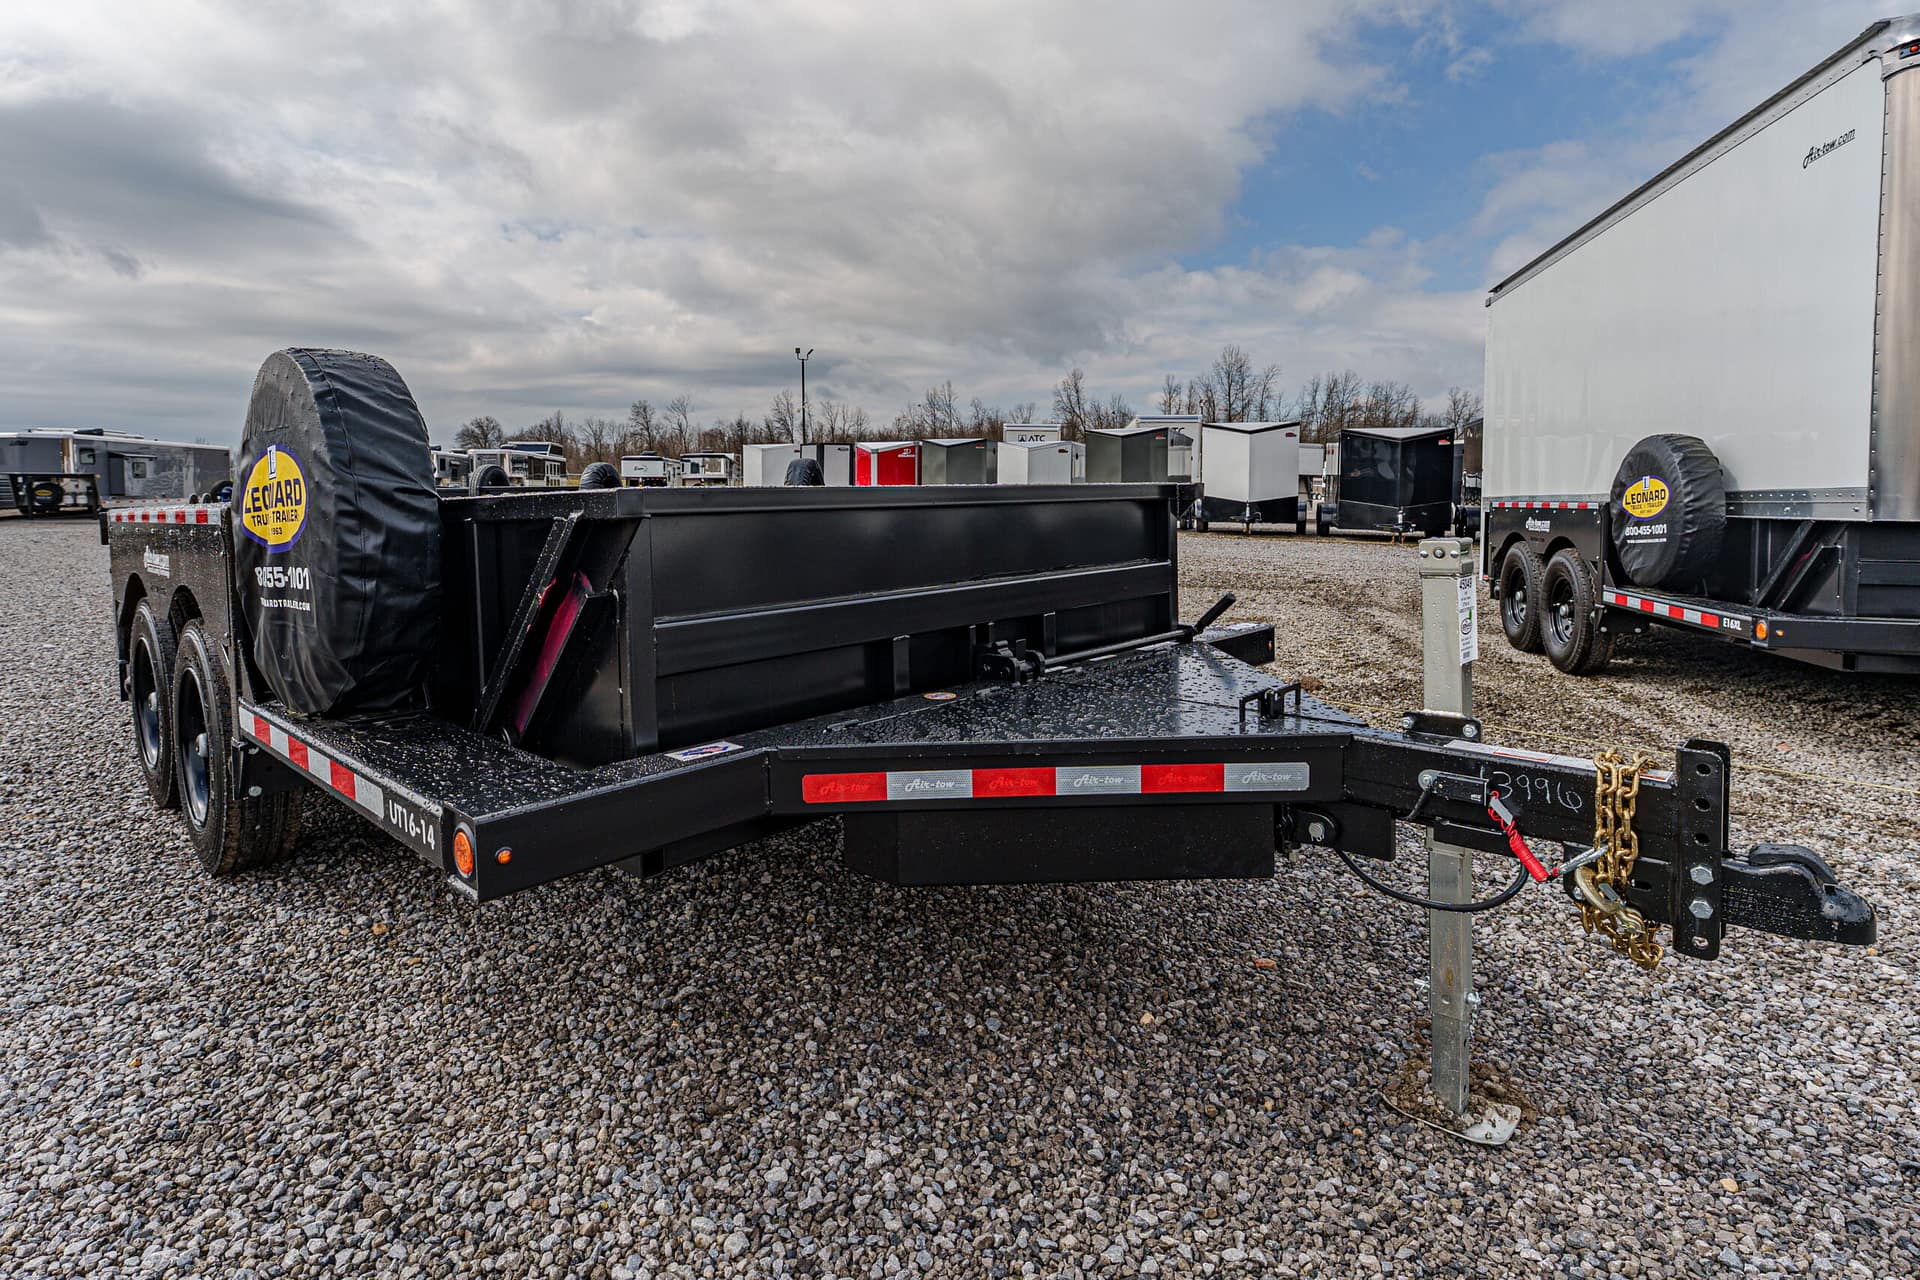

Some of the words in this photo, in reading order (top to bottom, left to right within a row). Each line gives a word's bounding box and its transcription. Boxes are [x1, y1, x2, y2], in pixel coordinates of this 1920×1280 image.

[1802, 128, 1856, 169] Air-tow.com
[1027, 434, 1046, 442] ATC
[1624, 488, 1667, 506] LEONARD
[1624, 523, 1668, 537] 800-455-1001
[819, 781, 870, 796] Air-tow
[904, 778, 955, 793] Air-tow
[988, 775, 1039, 791] Air-tow
[1073, 773, 1124, 788] Air-tow
[1241, 769, 1292, 784] Air-tow
[389, 799, 436, 850] UT16-14
